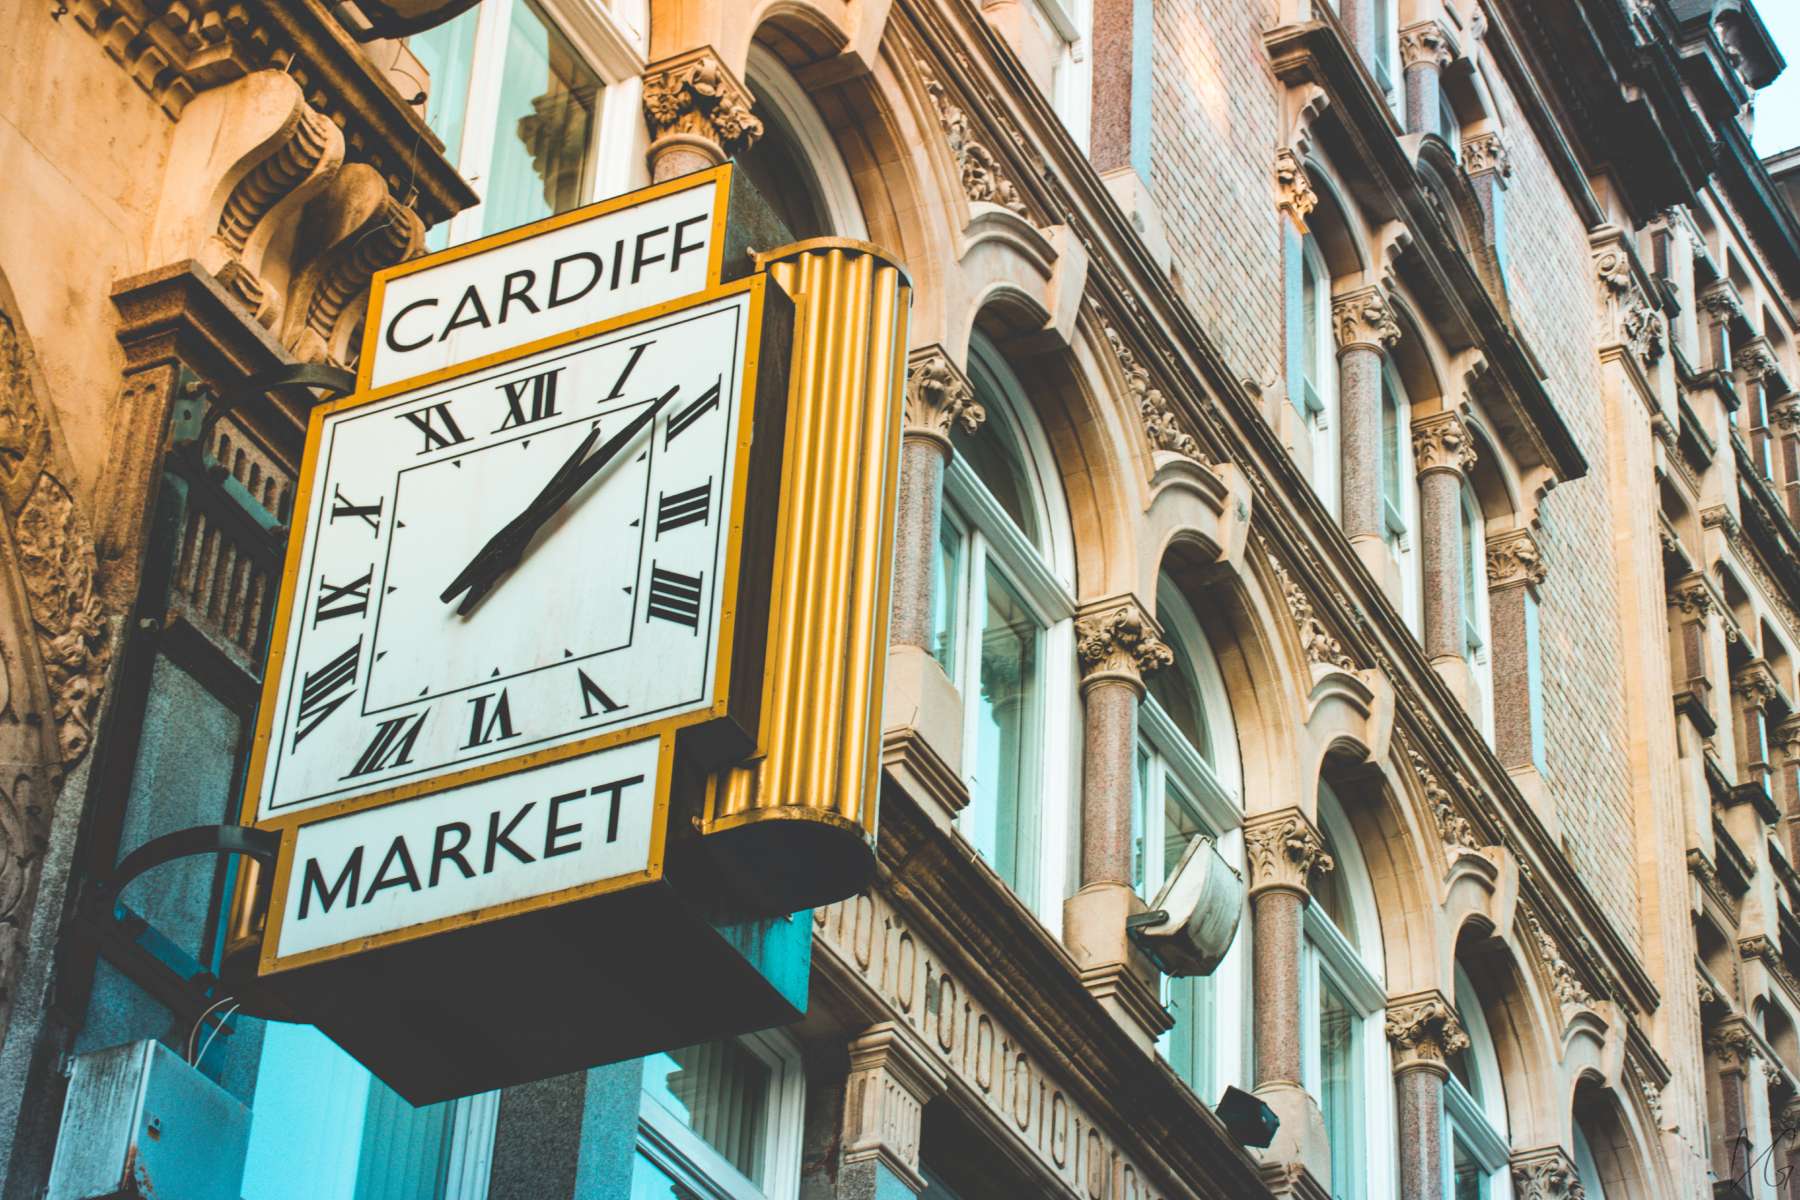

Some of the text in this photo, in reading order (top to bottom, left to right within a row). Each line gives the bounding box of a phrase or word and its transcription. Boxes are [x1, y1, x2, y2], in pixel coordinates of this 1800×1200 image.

[386, 214, 708, 353] CARDIFF
[491, 367, 567, 434] XII
[598, 340, 657, 403] I
[395, 401, 474, 455] XI
[665, 374, 722, 453] II
[330, 483, 384, 539] X
[655, 476, 713, 542] III
[313, 563, 375, 631] IX
[646, 559, 704, 637] IIII
[291, 633, 363, 755] VIII
[459, 687, 522, 750] VI
[578, 667, 629, 719] V
[338, 706, 432, 782] VII
[297, 774, 645, 921] MARKET
